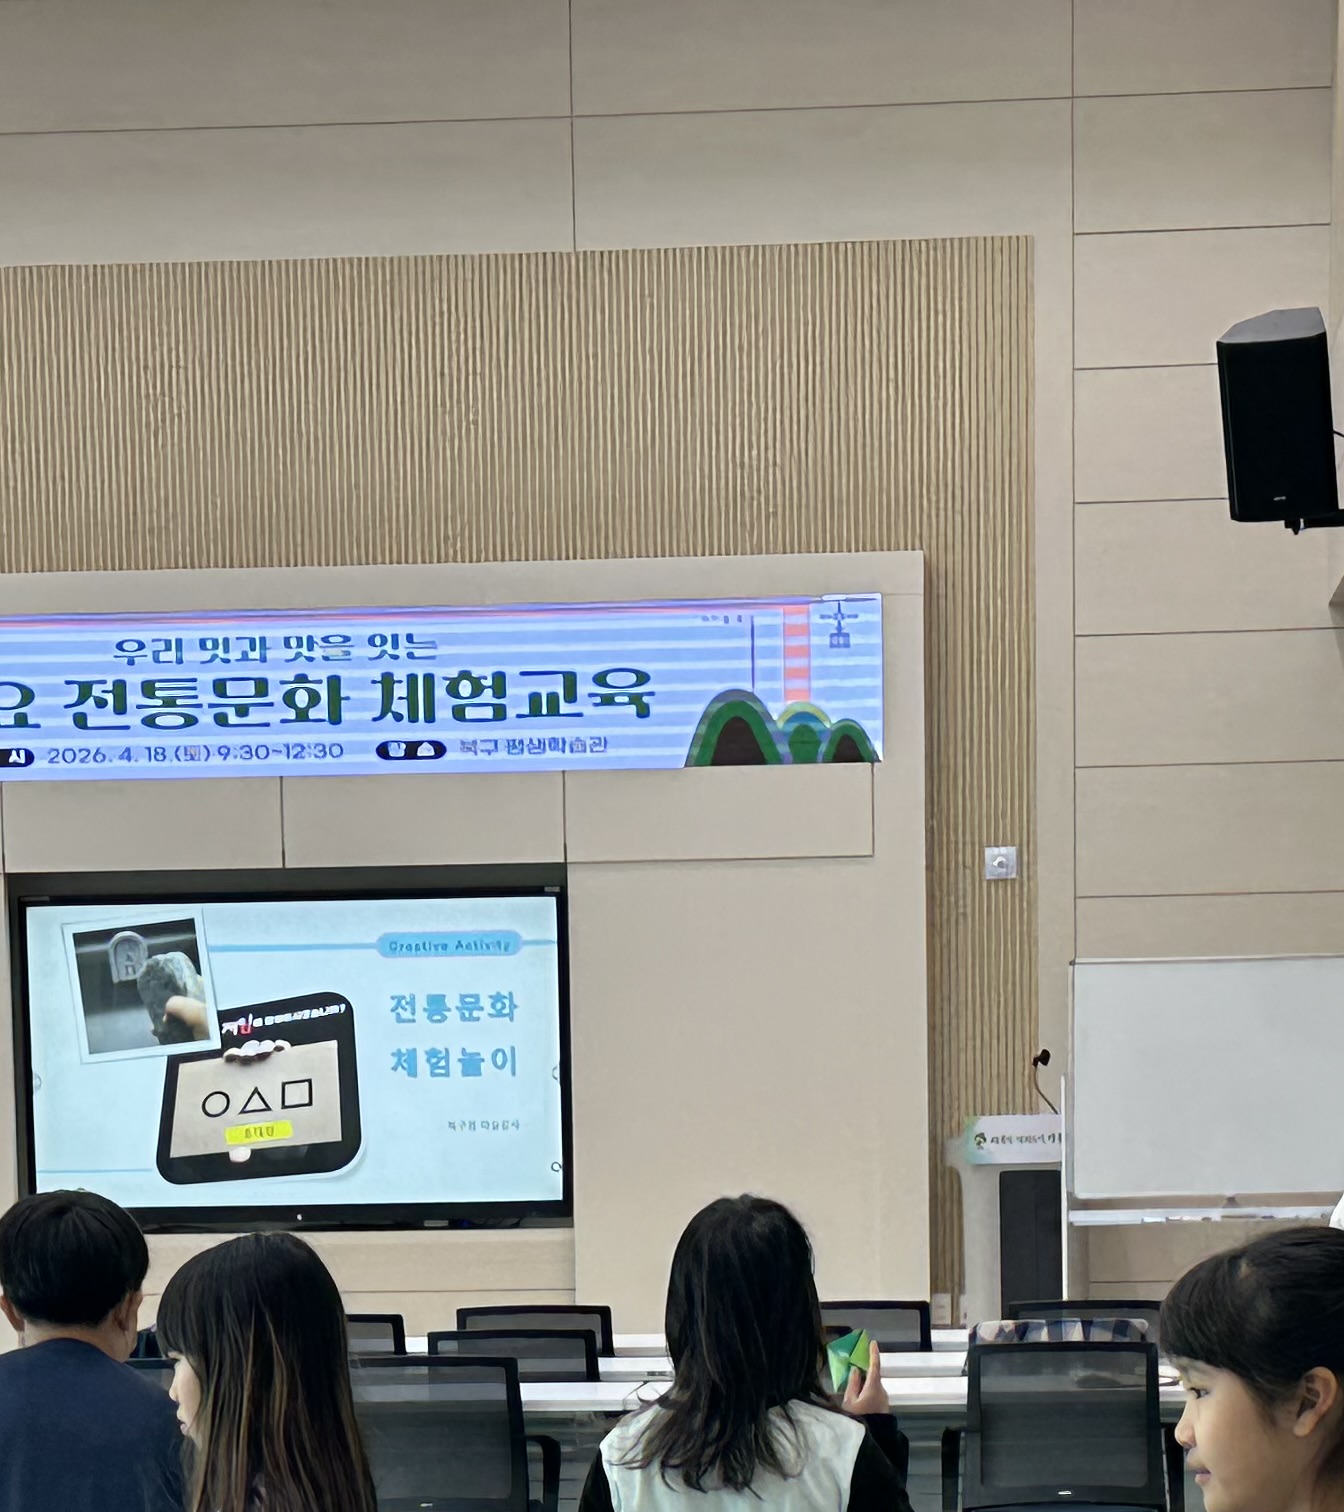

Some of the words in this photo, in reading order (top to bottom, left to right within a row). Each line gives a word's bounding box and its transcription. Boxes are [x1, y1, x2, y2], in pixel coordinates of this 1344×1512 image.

[113, 637, 184, 667] 우리
[282, 633, 355, 663] 맛을
[367, 632, 439, 662] 잇는
[63, 672, 351, 731] 전통문화
[370, 667, 656, 724] 체험교육
[390, 990, 519, 1024] 전통문화
